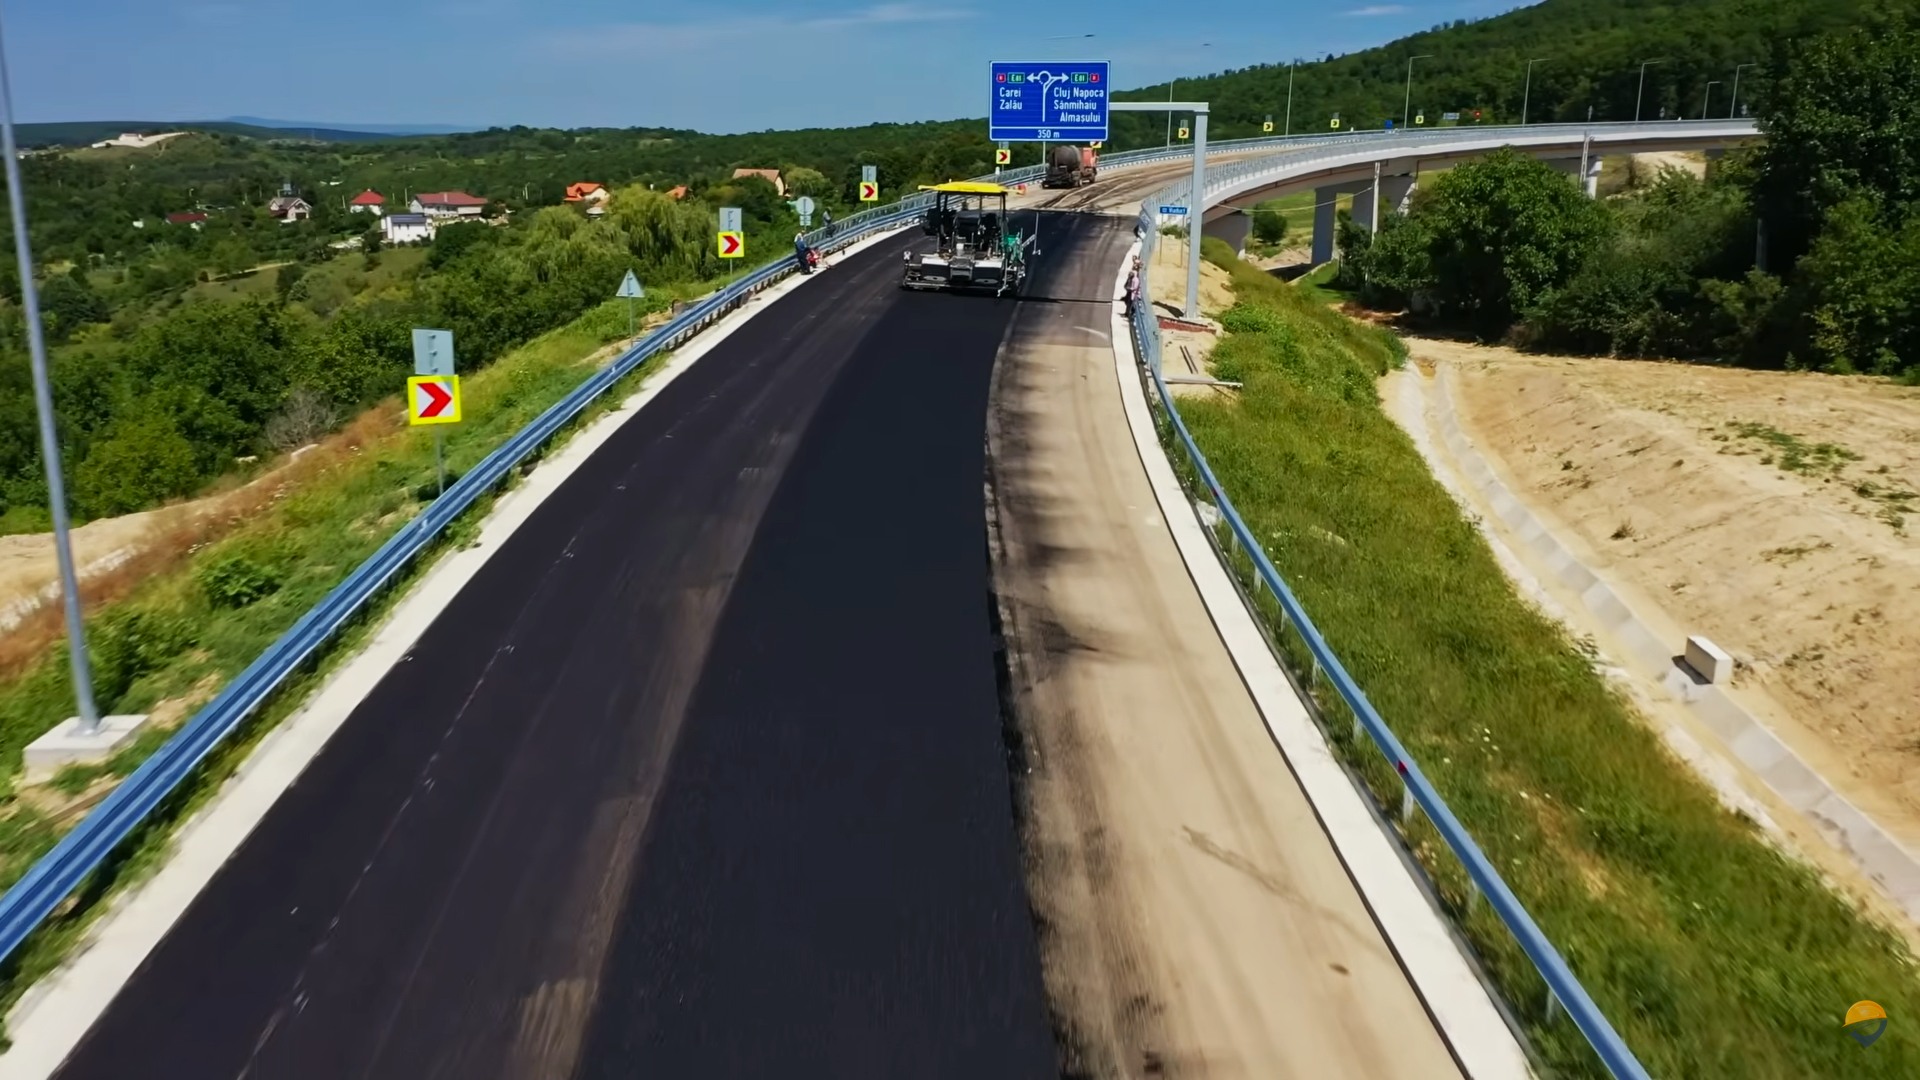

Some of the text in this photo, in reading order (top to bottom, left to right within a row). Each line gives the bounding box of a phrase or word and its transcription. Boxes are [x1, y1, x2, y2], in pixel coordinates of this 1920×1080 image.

[1000, 87, 1021, 97] Carei
[1054, 87, 1104, 99] Cluj Napoca
[1038, 130, 1051, 138] 350
